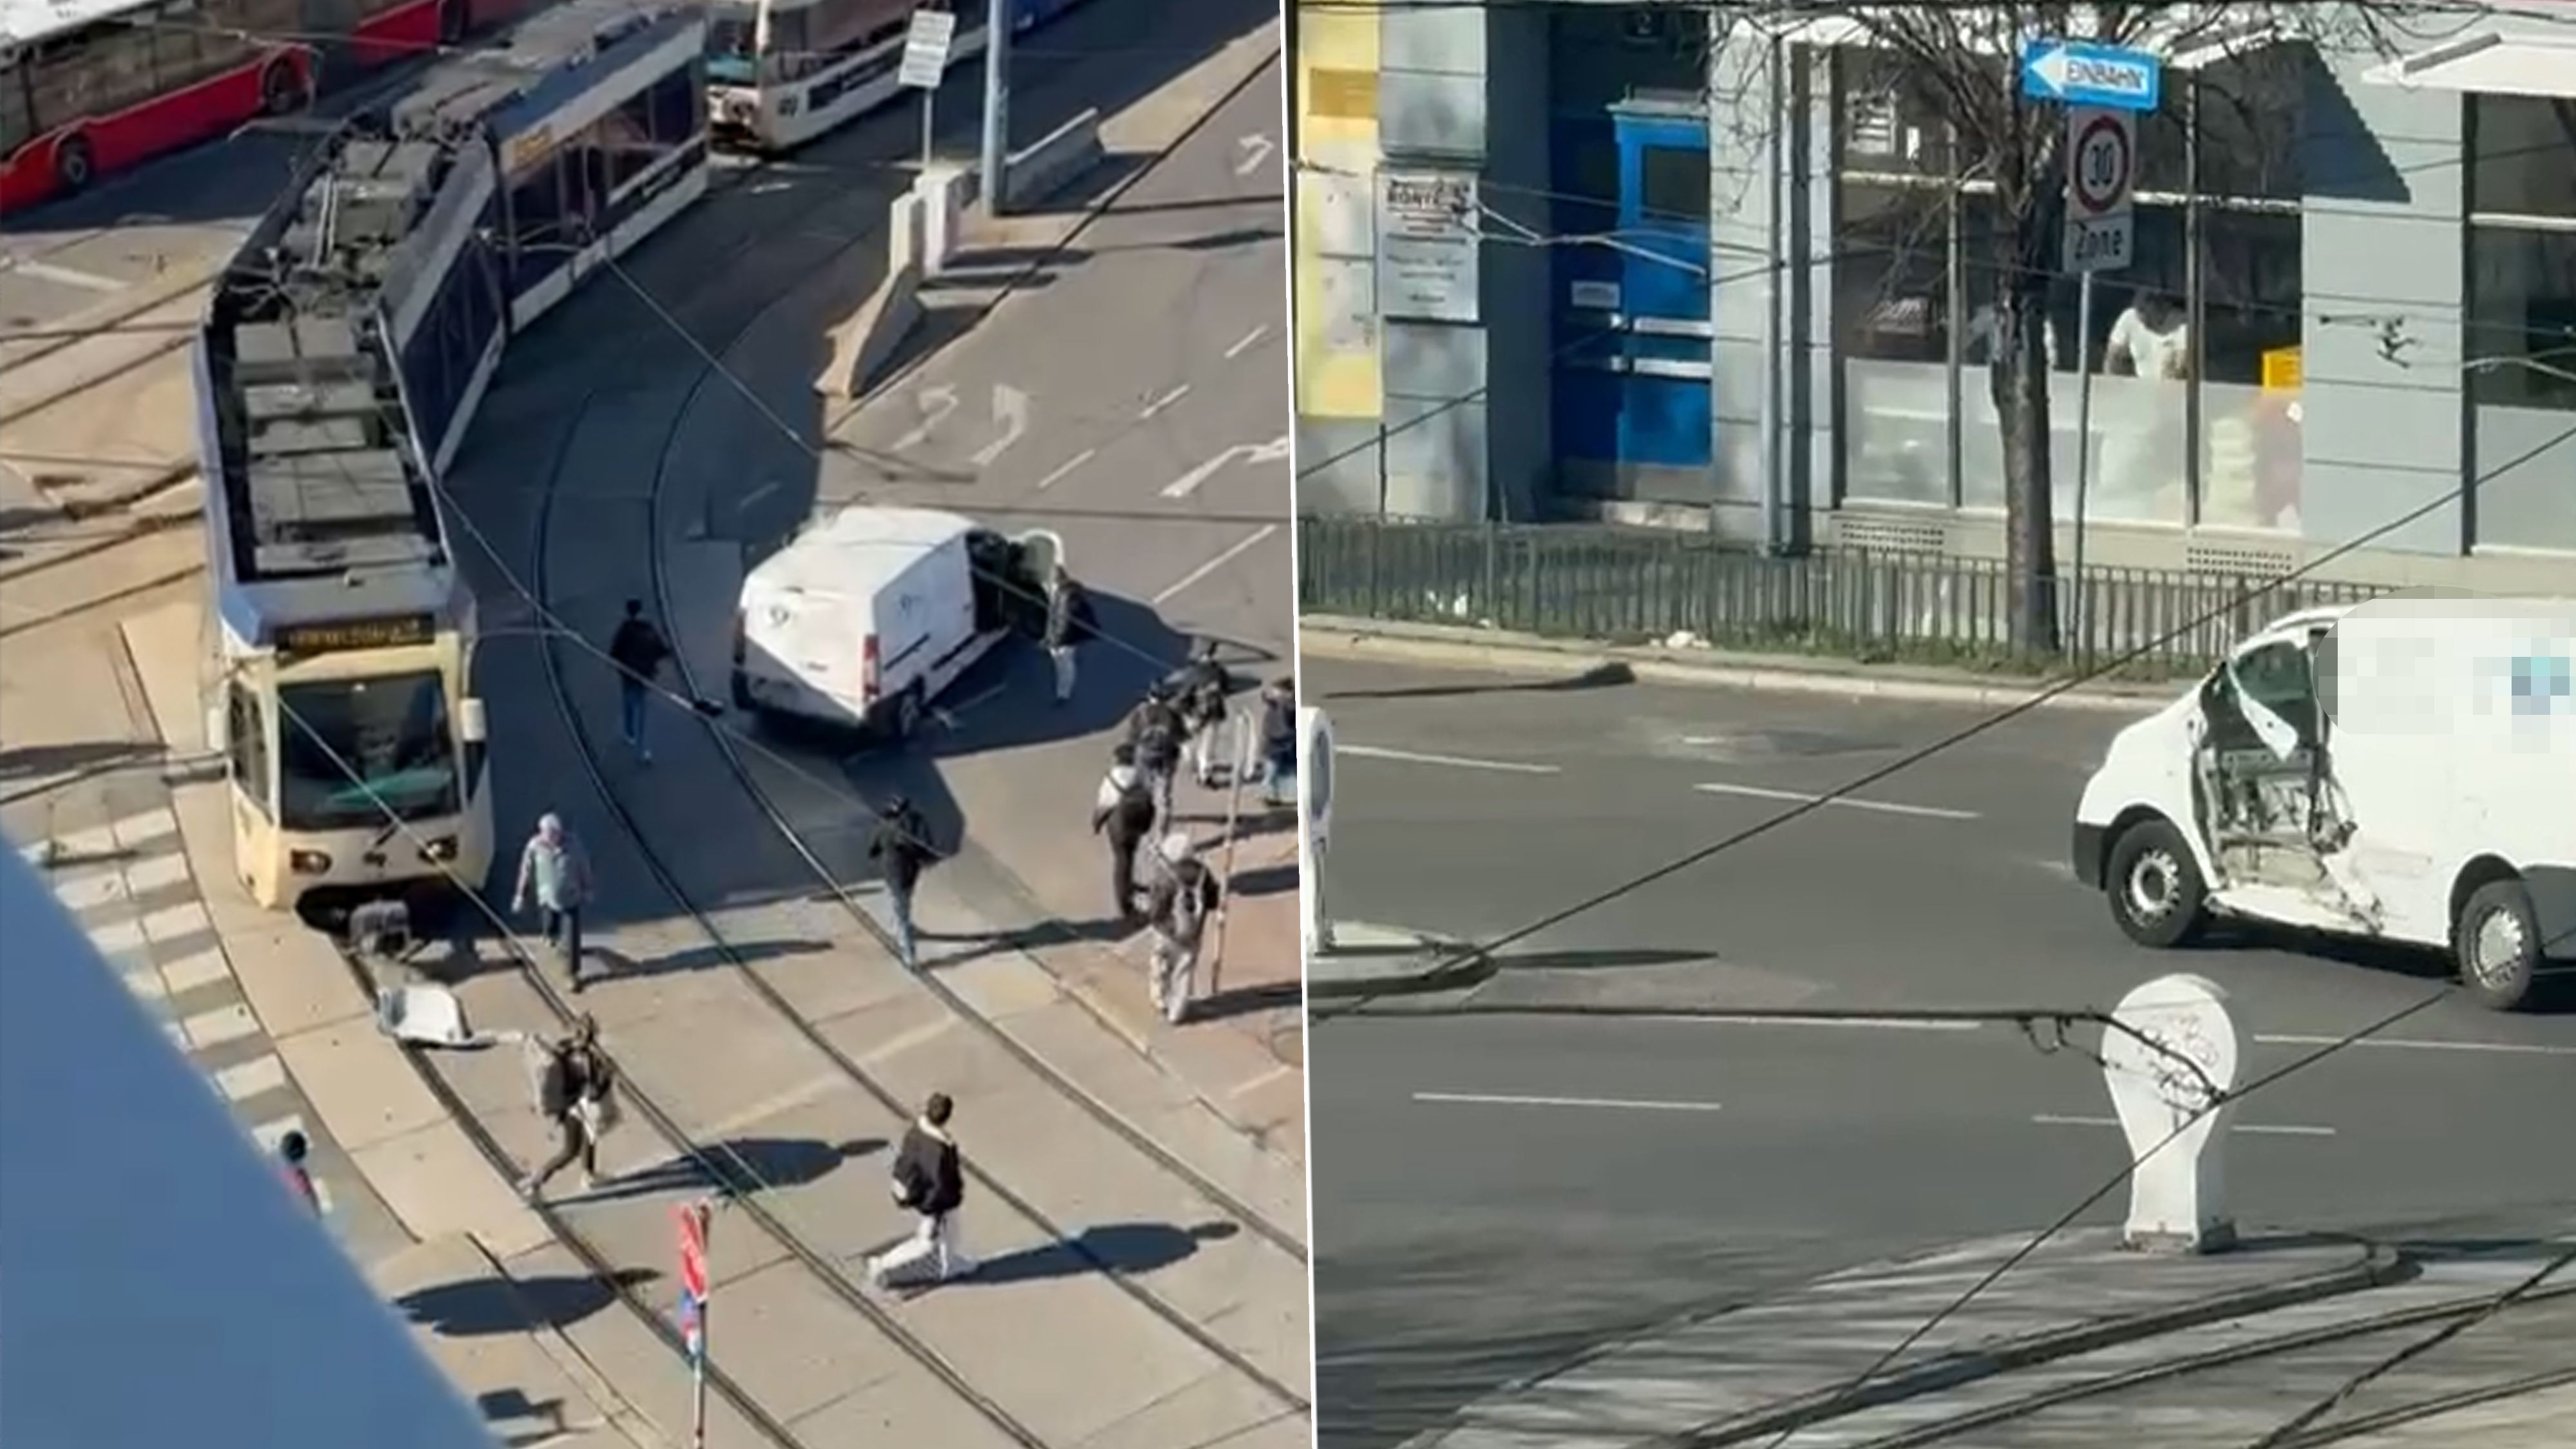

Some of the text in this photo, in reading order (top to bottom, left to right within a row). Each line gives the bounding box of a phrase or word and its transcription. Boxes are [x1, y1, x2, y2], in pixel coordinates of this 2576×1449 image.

[2066, 59, 2145, 88] EINBAHN
[2088, 142, 2115, 187] 30
[2072, 220, 2123, 260] Zone
